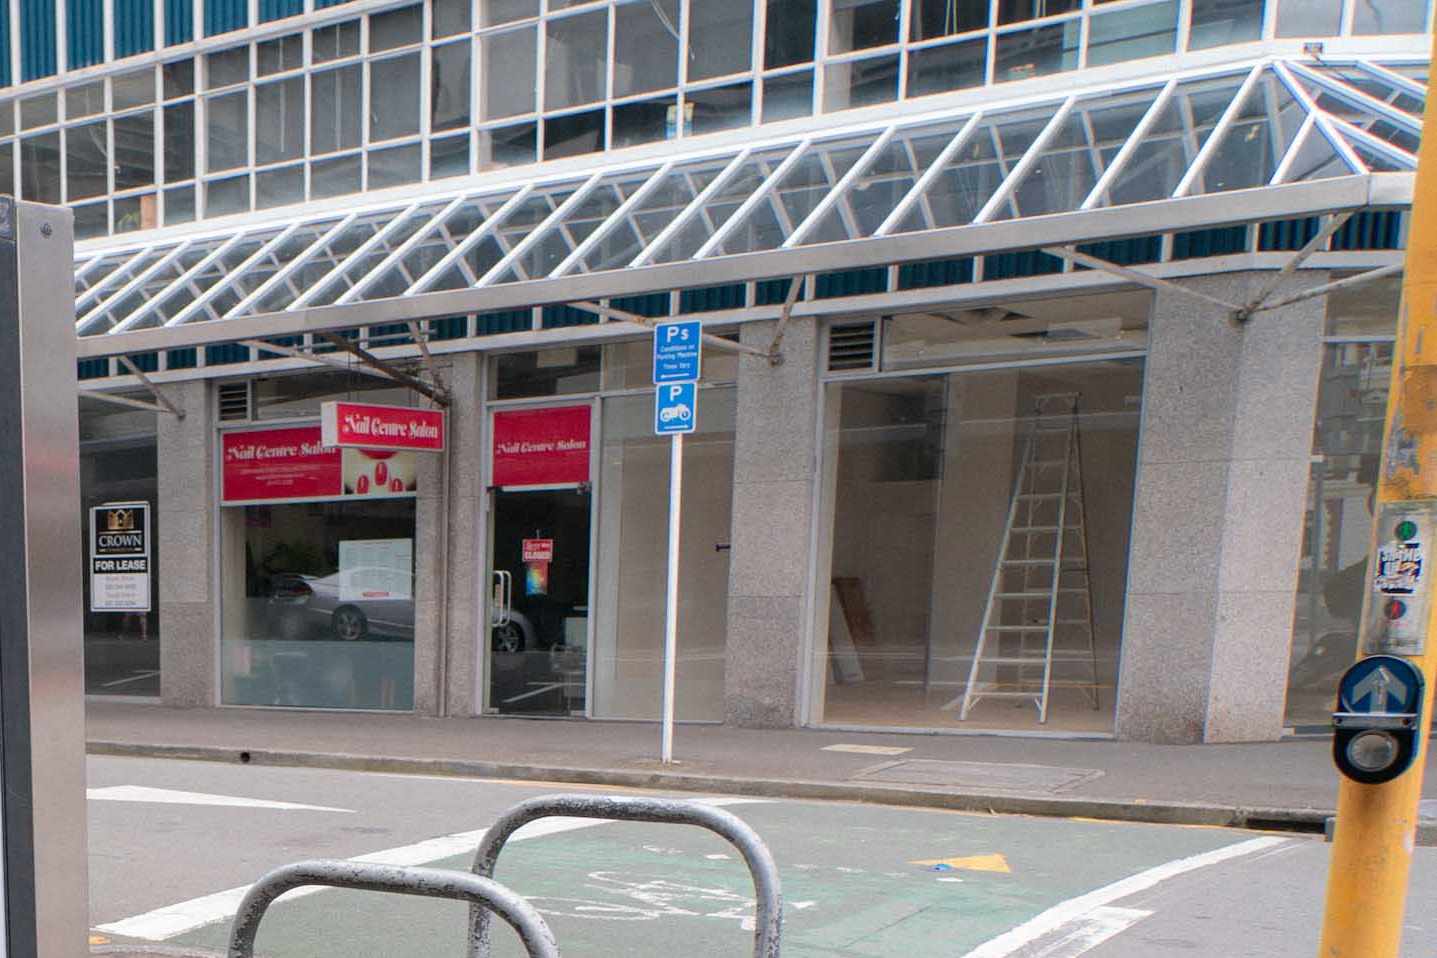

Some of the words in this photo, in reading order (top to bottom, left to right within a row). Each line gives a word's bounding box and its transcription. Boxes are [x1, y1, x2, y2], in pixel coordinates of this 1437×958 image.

[670, 385, 683, 401] P
[343, 413, 370, 433] Nail
[370, 419, 407, 437] Centre
[408, 423, 439, 439] Salon
[227, 444, 256, 461] Nail
[256, 443, 298, 460] Centre
[496, 444, 520, 455] Nail
[520, 442, 555, 453] Centre
[556, 440, 587, 451] Salon
[99, 535, 143, 548] CROWN
[95, 560, 115, 572] FOR
[116, 559, 147, 571] LEASE
